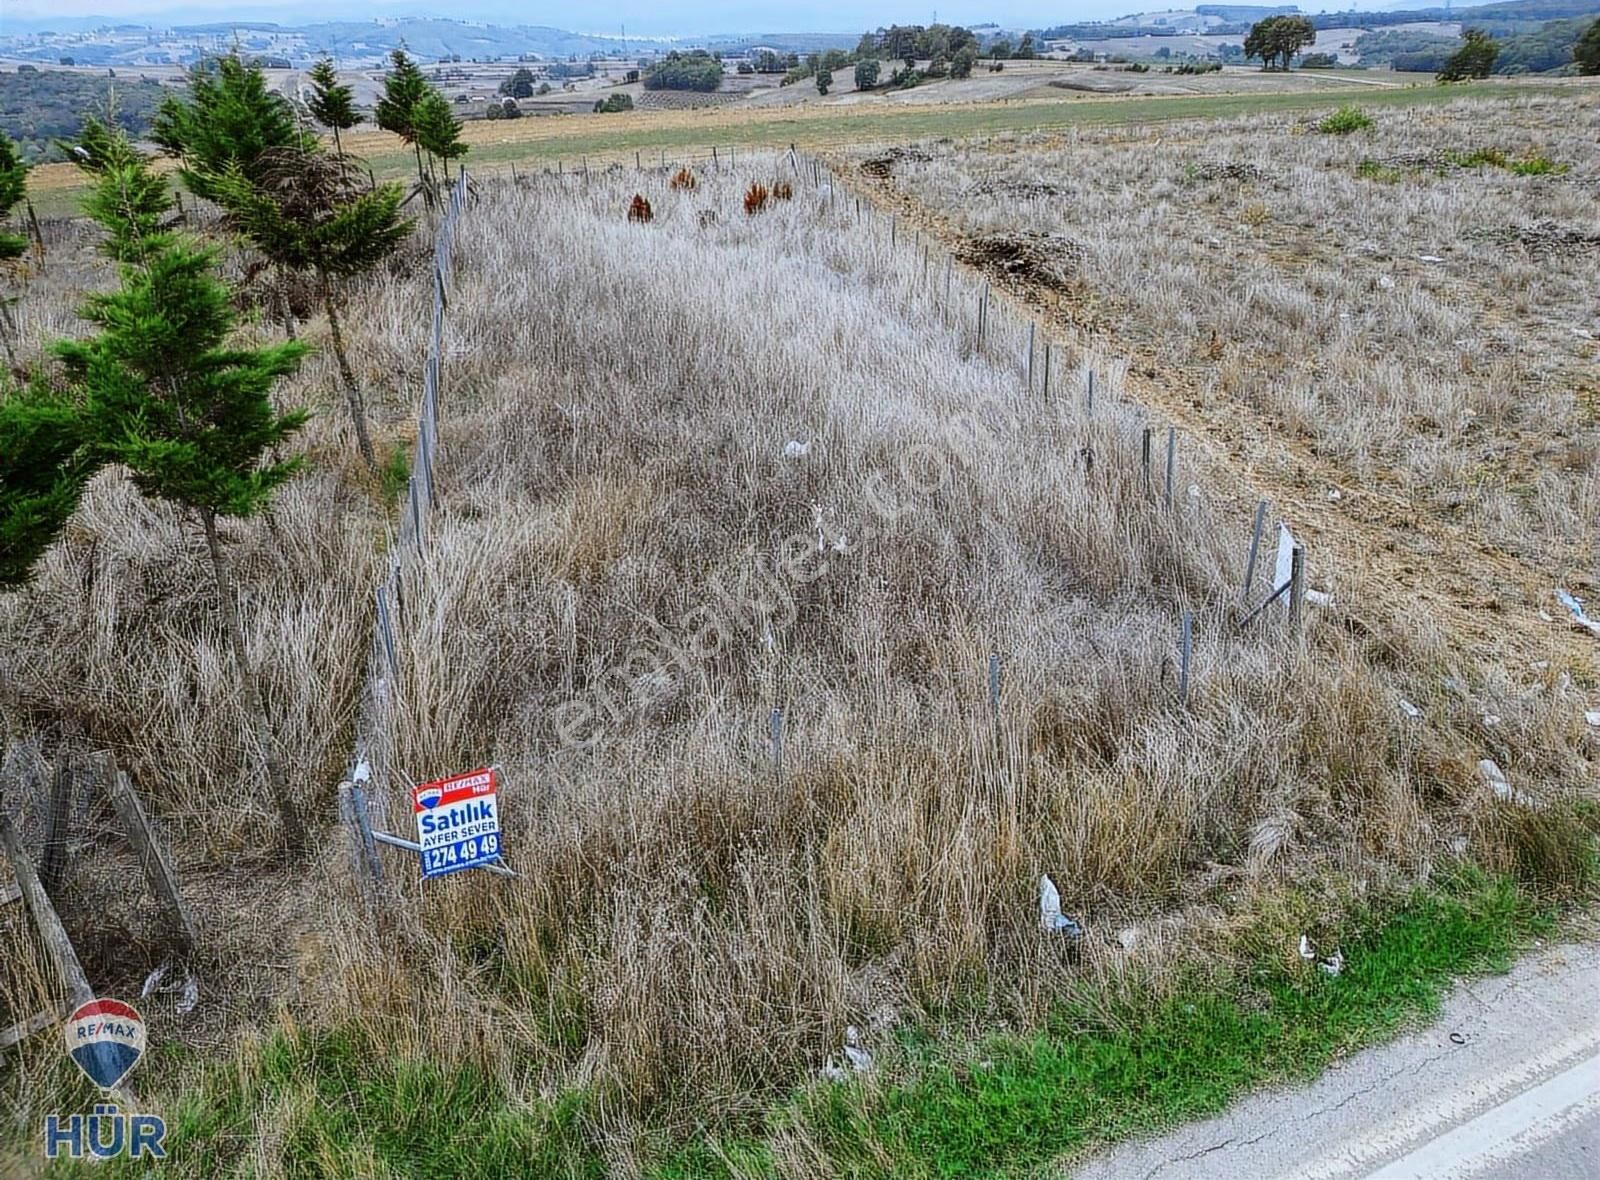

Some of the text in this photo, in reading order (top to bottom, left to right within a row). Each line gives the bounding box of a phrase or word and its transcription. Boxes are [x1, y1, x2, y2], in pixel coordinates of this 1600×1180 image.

[422, 800, 493, 834] Satılık
[423, 821, 496, 848] AYFER SEVER
[431, 845, 457, 868] 274
[460, 841, 478, 860] 49
[481, 835, 498, 855] 49
